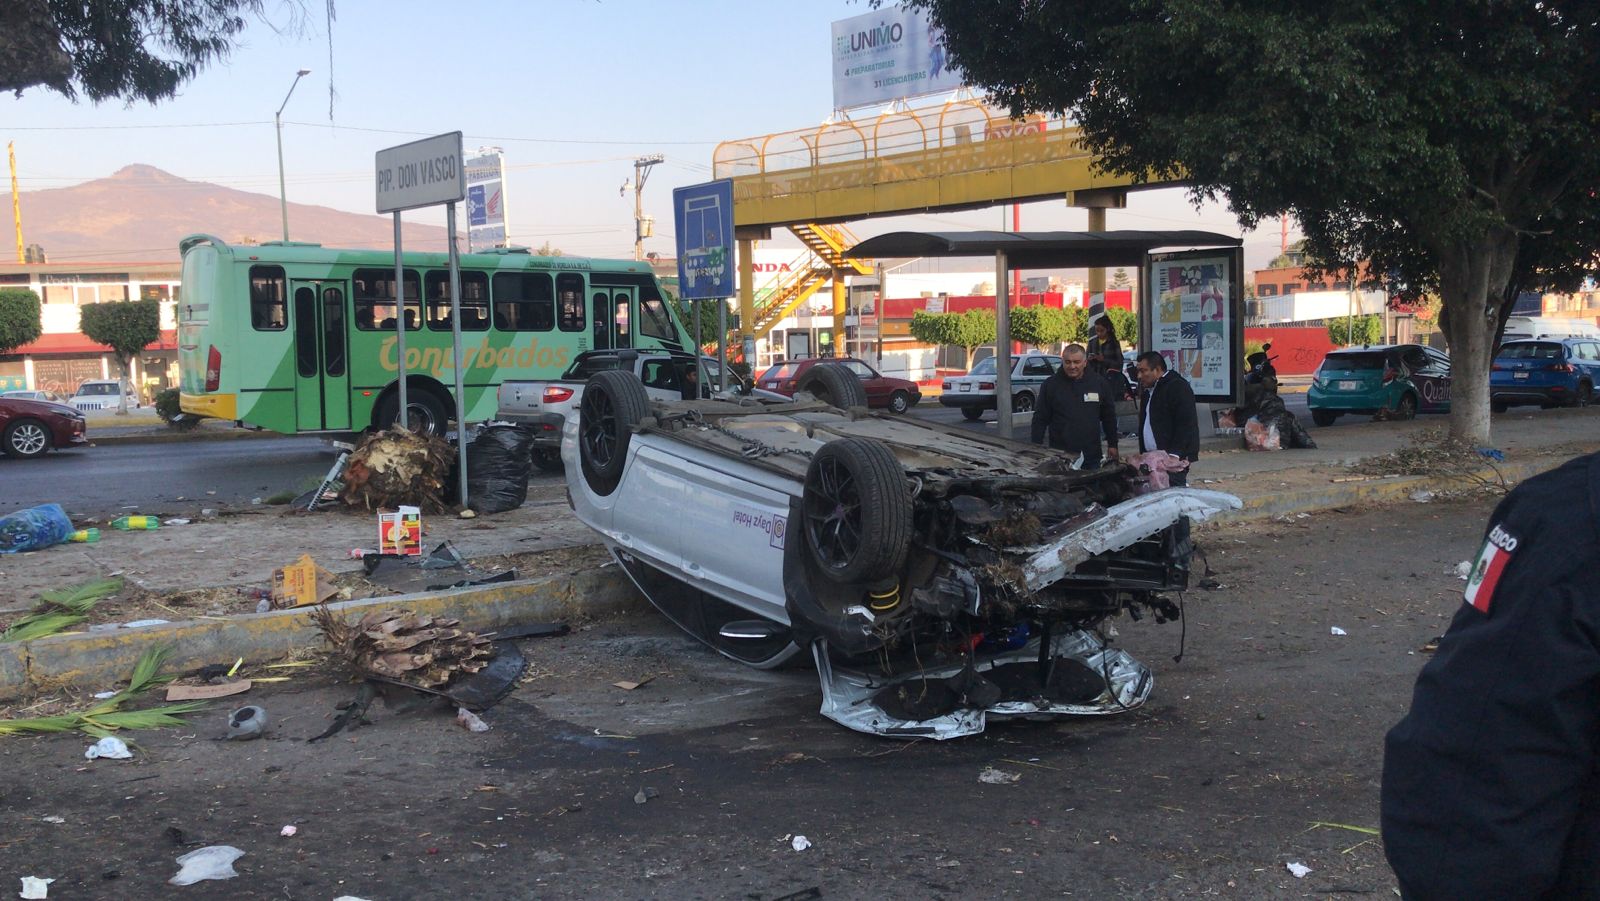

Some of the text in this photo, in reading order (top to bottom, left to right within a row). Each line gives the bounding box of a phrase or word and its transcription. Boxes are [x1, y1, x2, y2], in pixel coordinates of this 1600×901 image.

[851, 22, 903, 52] UNIMO
[844, 69, 850, 77] 4
[378, 154, 456, 192] PIP. DON VASCO
[737, 263, 792, 273] NDA
[379, 335, 569, 377] Conurbados
[733, 510, 772, 534] Dayz Hotel
